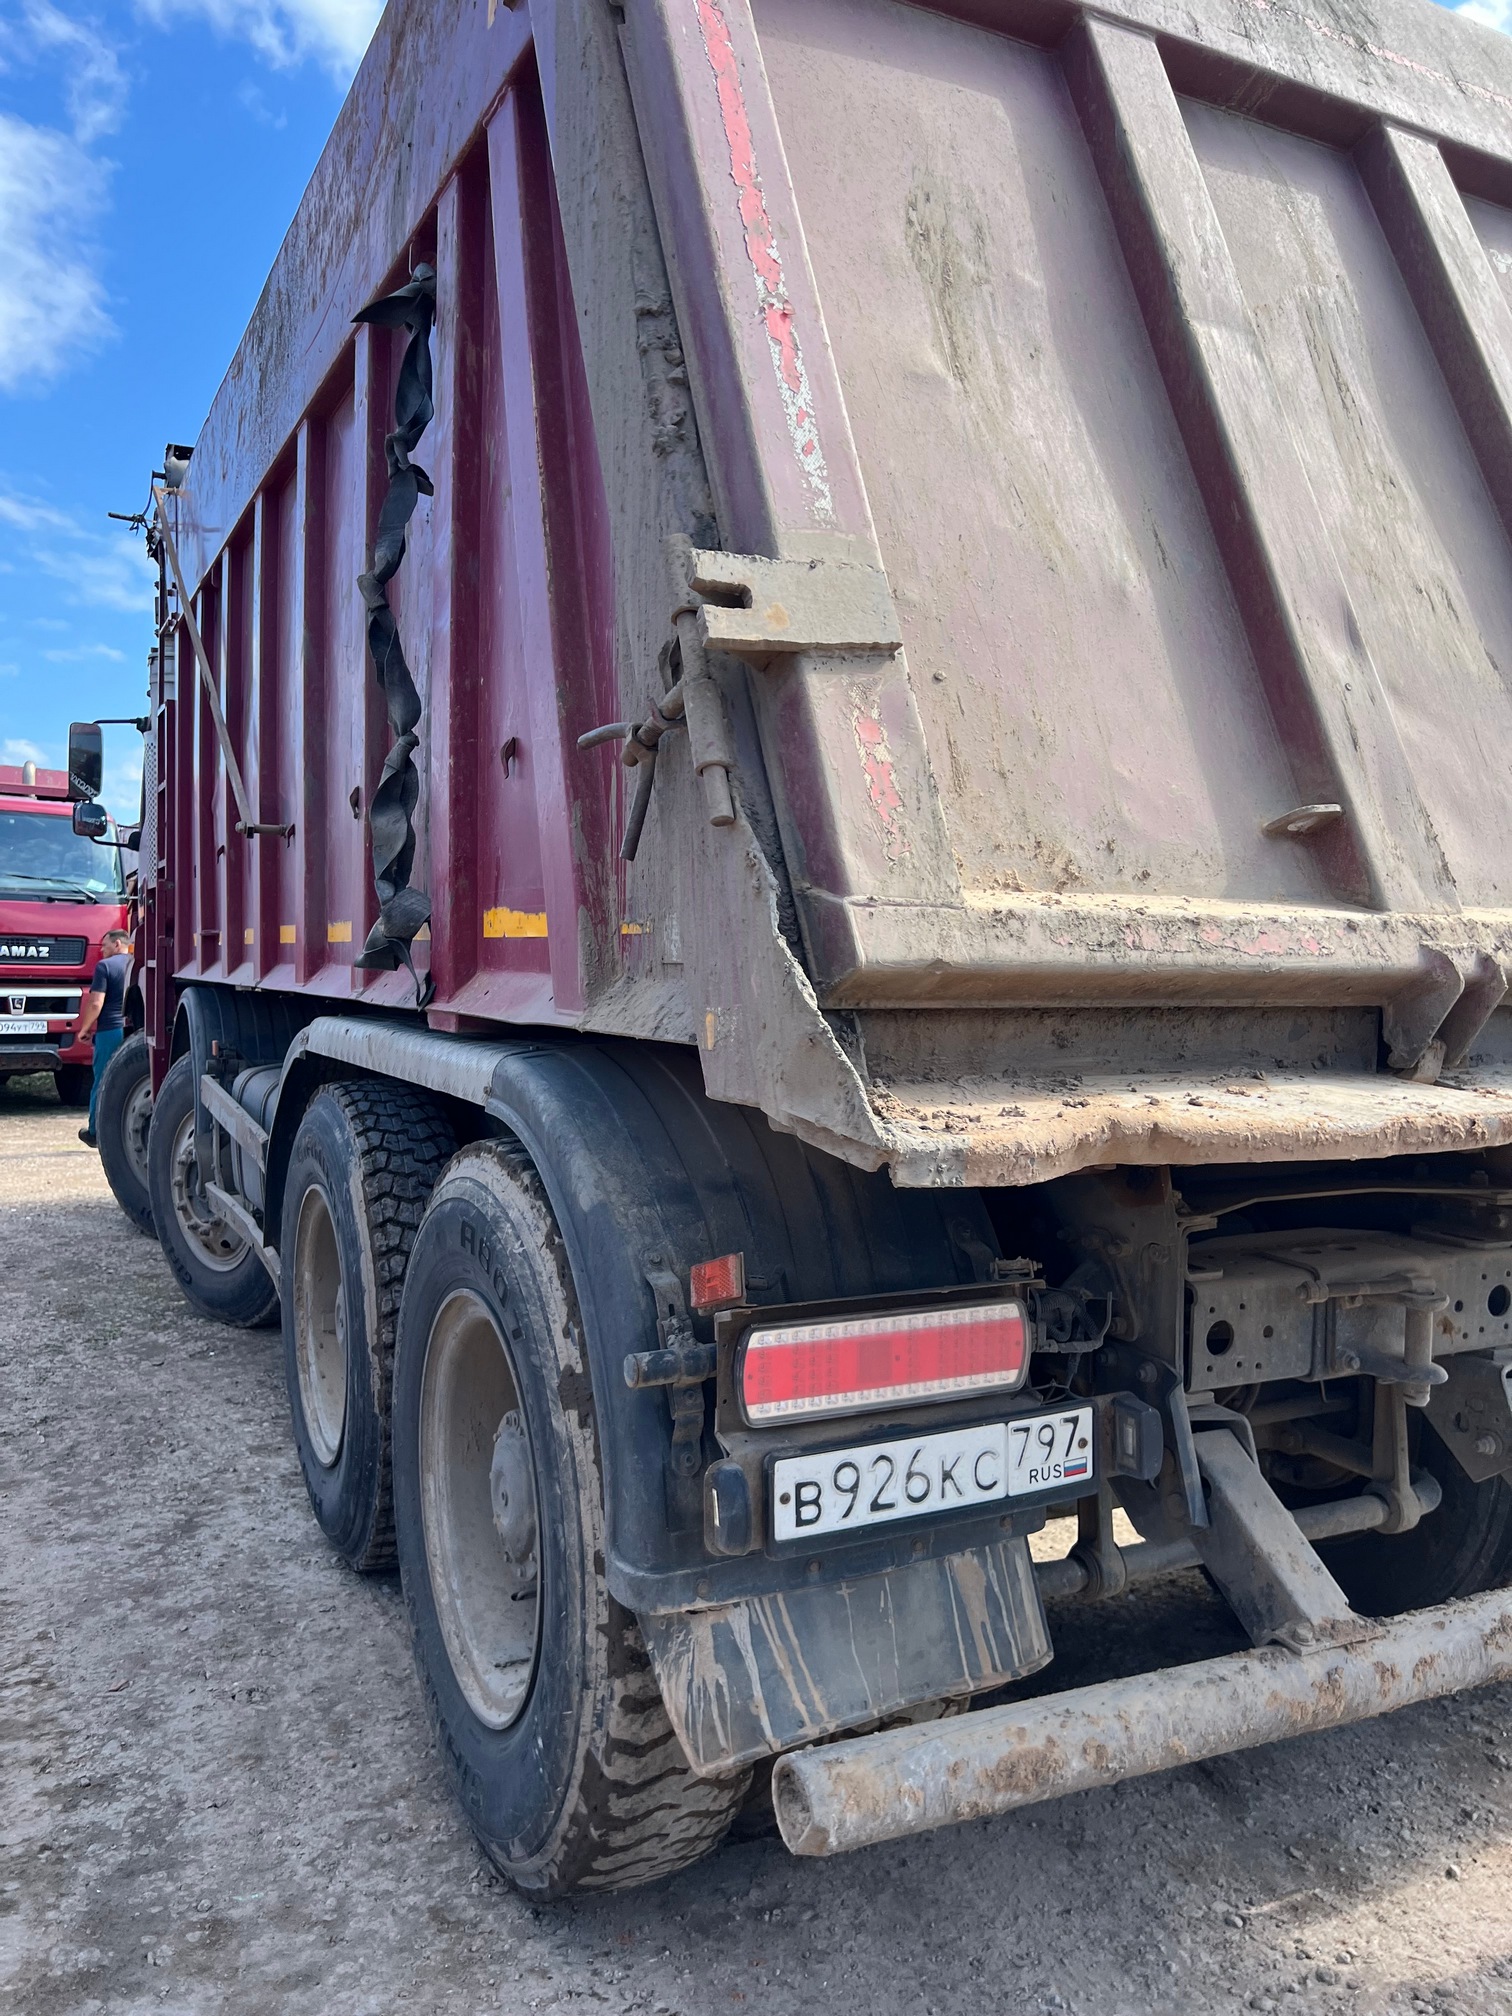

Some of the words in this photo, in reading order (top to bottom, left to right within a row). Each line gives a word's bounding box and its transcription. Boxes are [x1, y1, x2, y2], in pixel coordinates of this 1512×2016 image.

[0, 945, 49, 957] AMAZ
[795, 1448, 998, 1528] В926КС
[1012, 1415, 1080, 1468] 797
[1029, 1463, 1062, 1484] RUS
